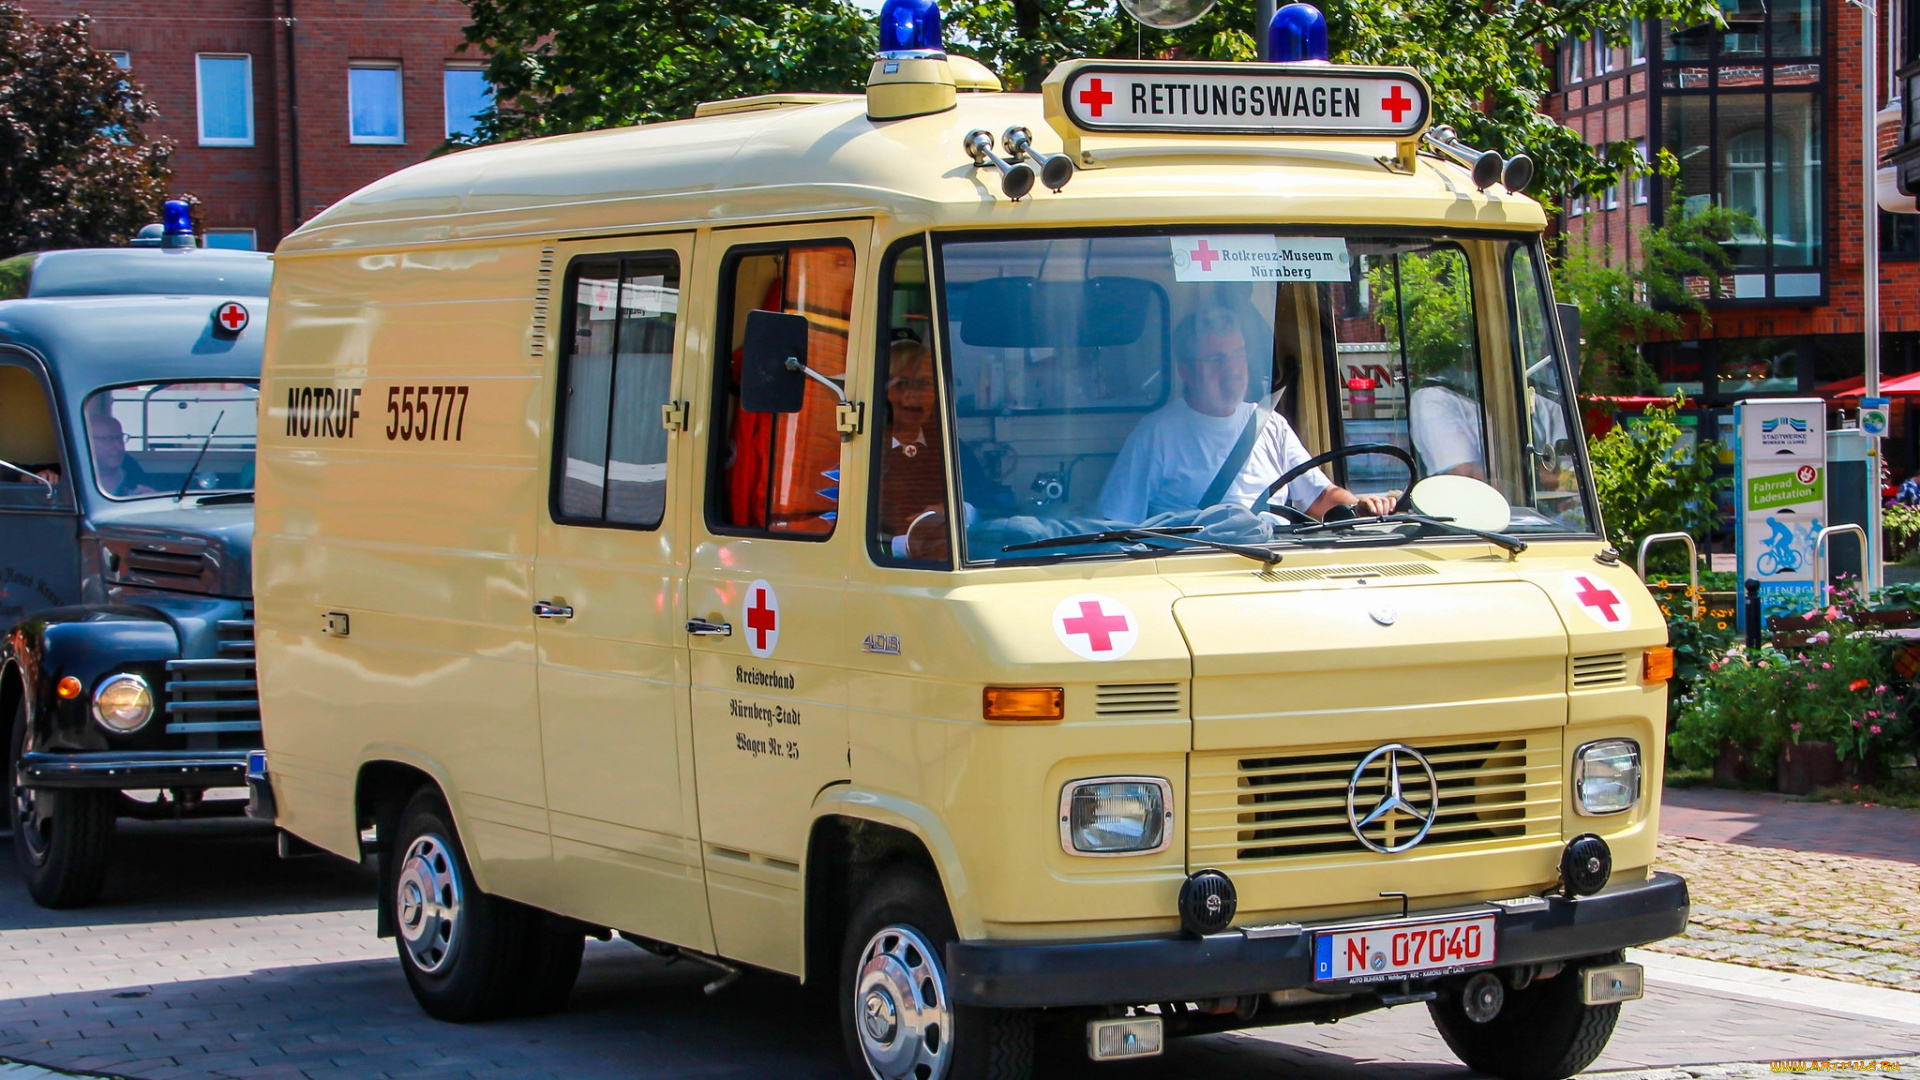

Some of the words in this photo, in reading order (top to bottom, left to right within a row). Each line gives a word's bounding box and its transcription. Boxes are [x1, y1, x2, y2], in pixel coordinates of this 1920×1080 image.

[1131, 82, 1360, 118] RETTUNGSWAGEN
[1222, 249, 1334, 262] Rotkreuz-Museum
[1250, 265, 1312, 279] Nürnberg
[286, 386, 362, 439] NOTRUF
[386, 386, 470, 441] 555777
[1753, 478, 1793, 492] Fahrrad
[1754, 488, 1812, 505] Ladestation
[862, 632, 901, 652] 408
[736, 665, 795, 690] Kreisverband
[730, 699, 801, 727] Nürnberg-Stadt
[736, 732, 767, 757] Wagen
[768, 738, 784, 757] Nr.
[786, 741, 800, 760] 25
[1347, 937, 1367, 972] N
[1392, 924, 1481, 967] 07040
[1320, 962, 1328, 972] D
